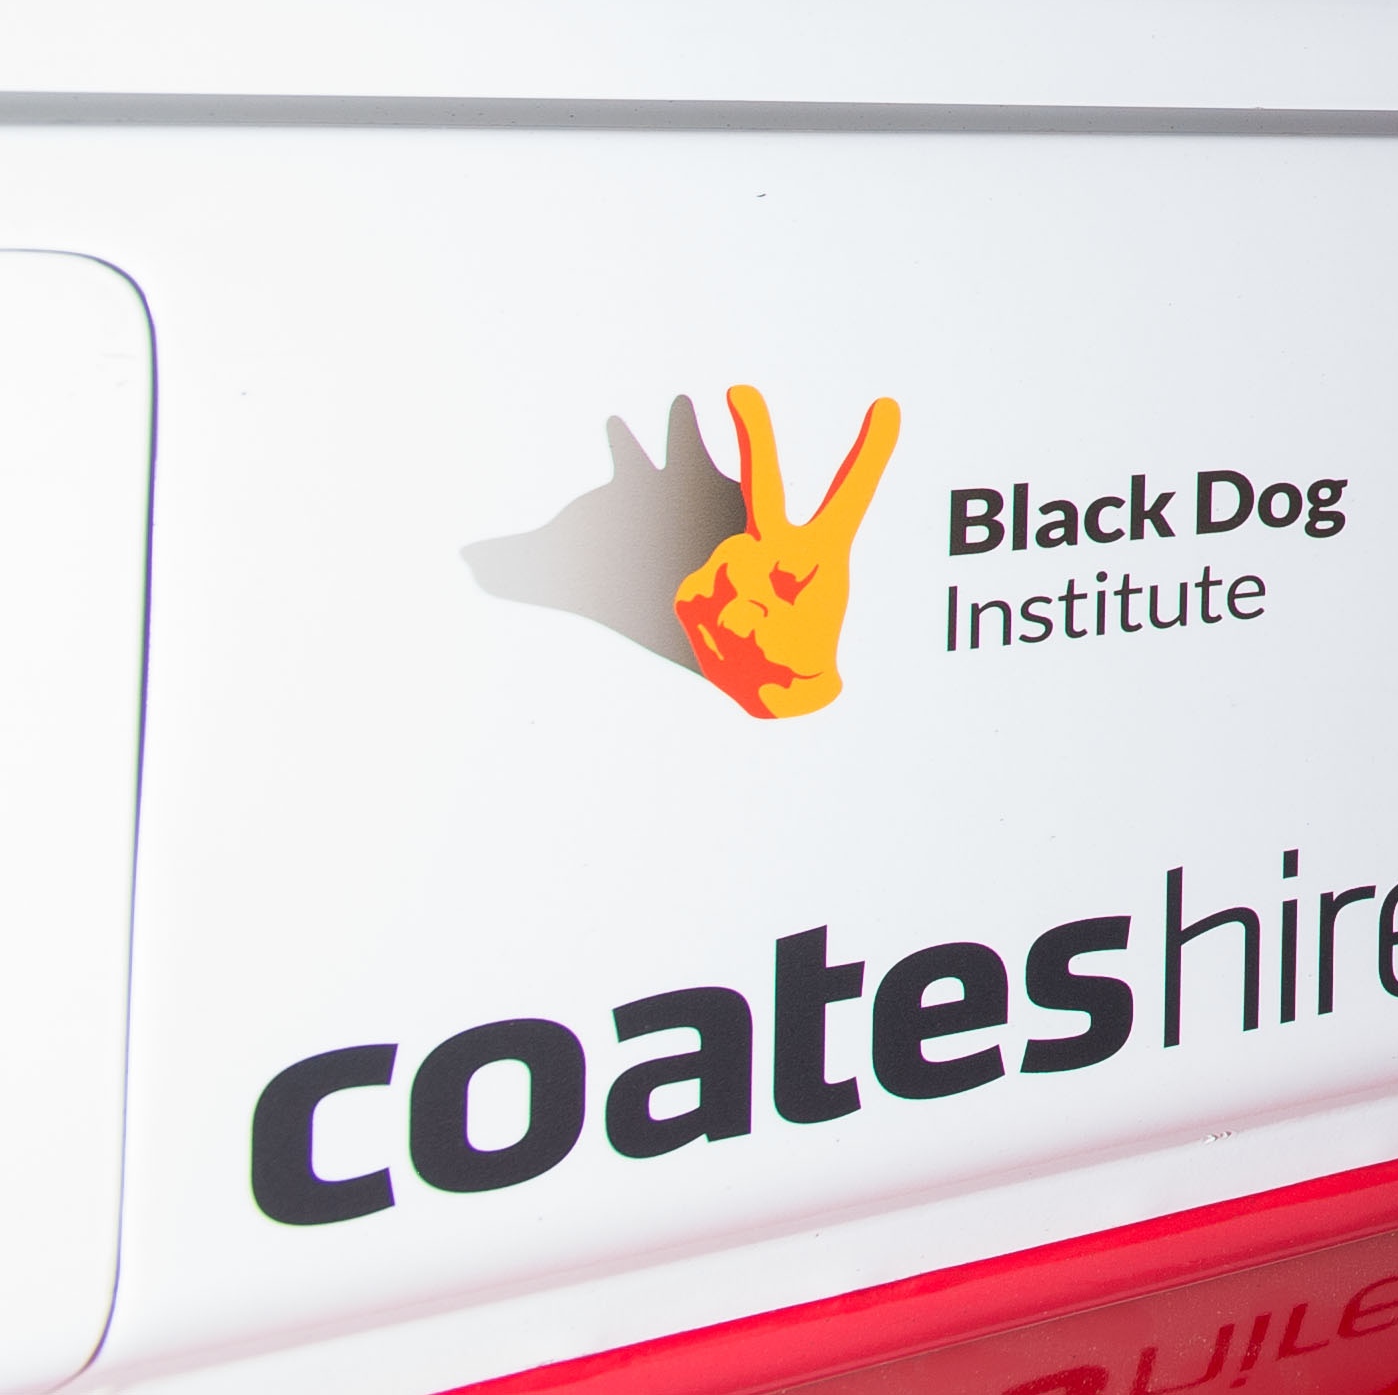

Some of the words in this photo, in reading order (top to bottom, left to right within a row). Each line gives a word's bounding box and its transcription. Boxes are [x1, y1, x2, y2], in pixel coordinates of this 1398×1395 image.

[949, 474, 1176, 557] Black
[1196, 470, 1348, 539] Dog
[947, 565, 1266, 652] Institute
